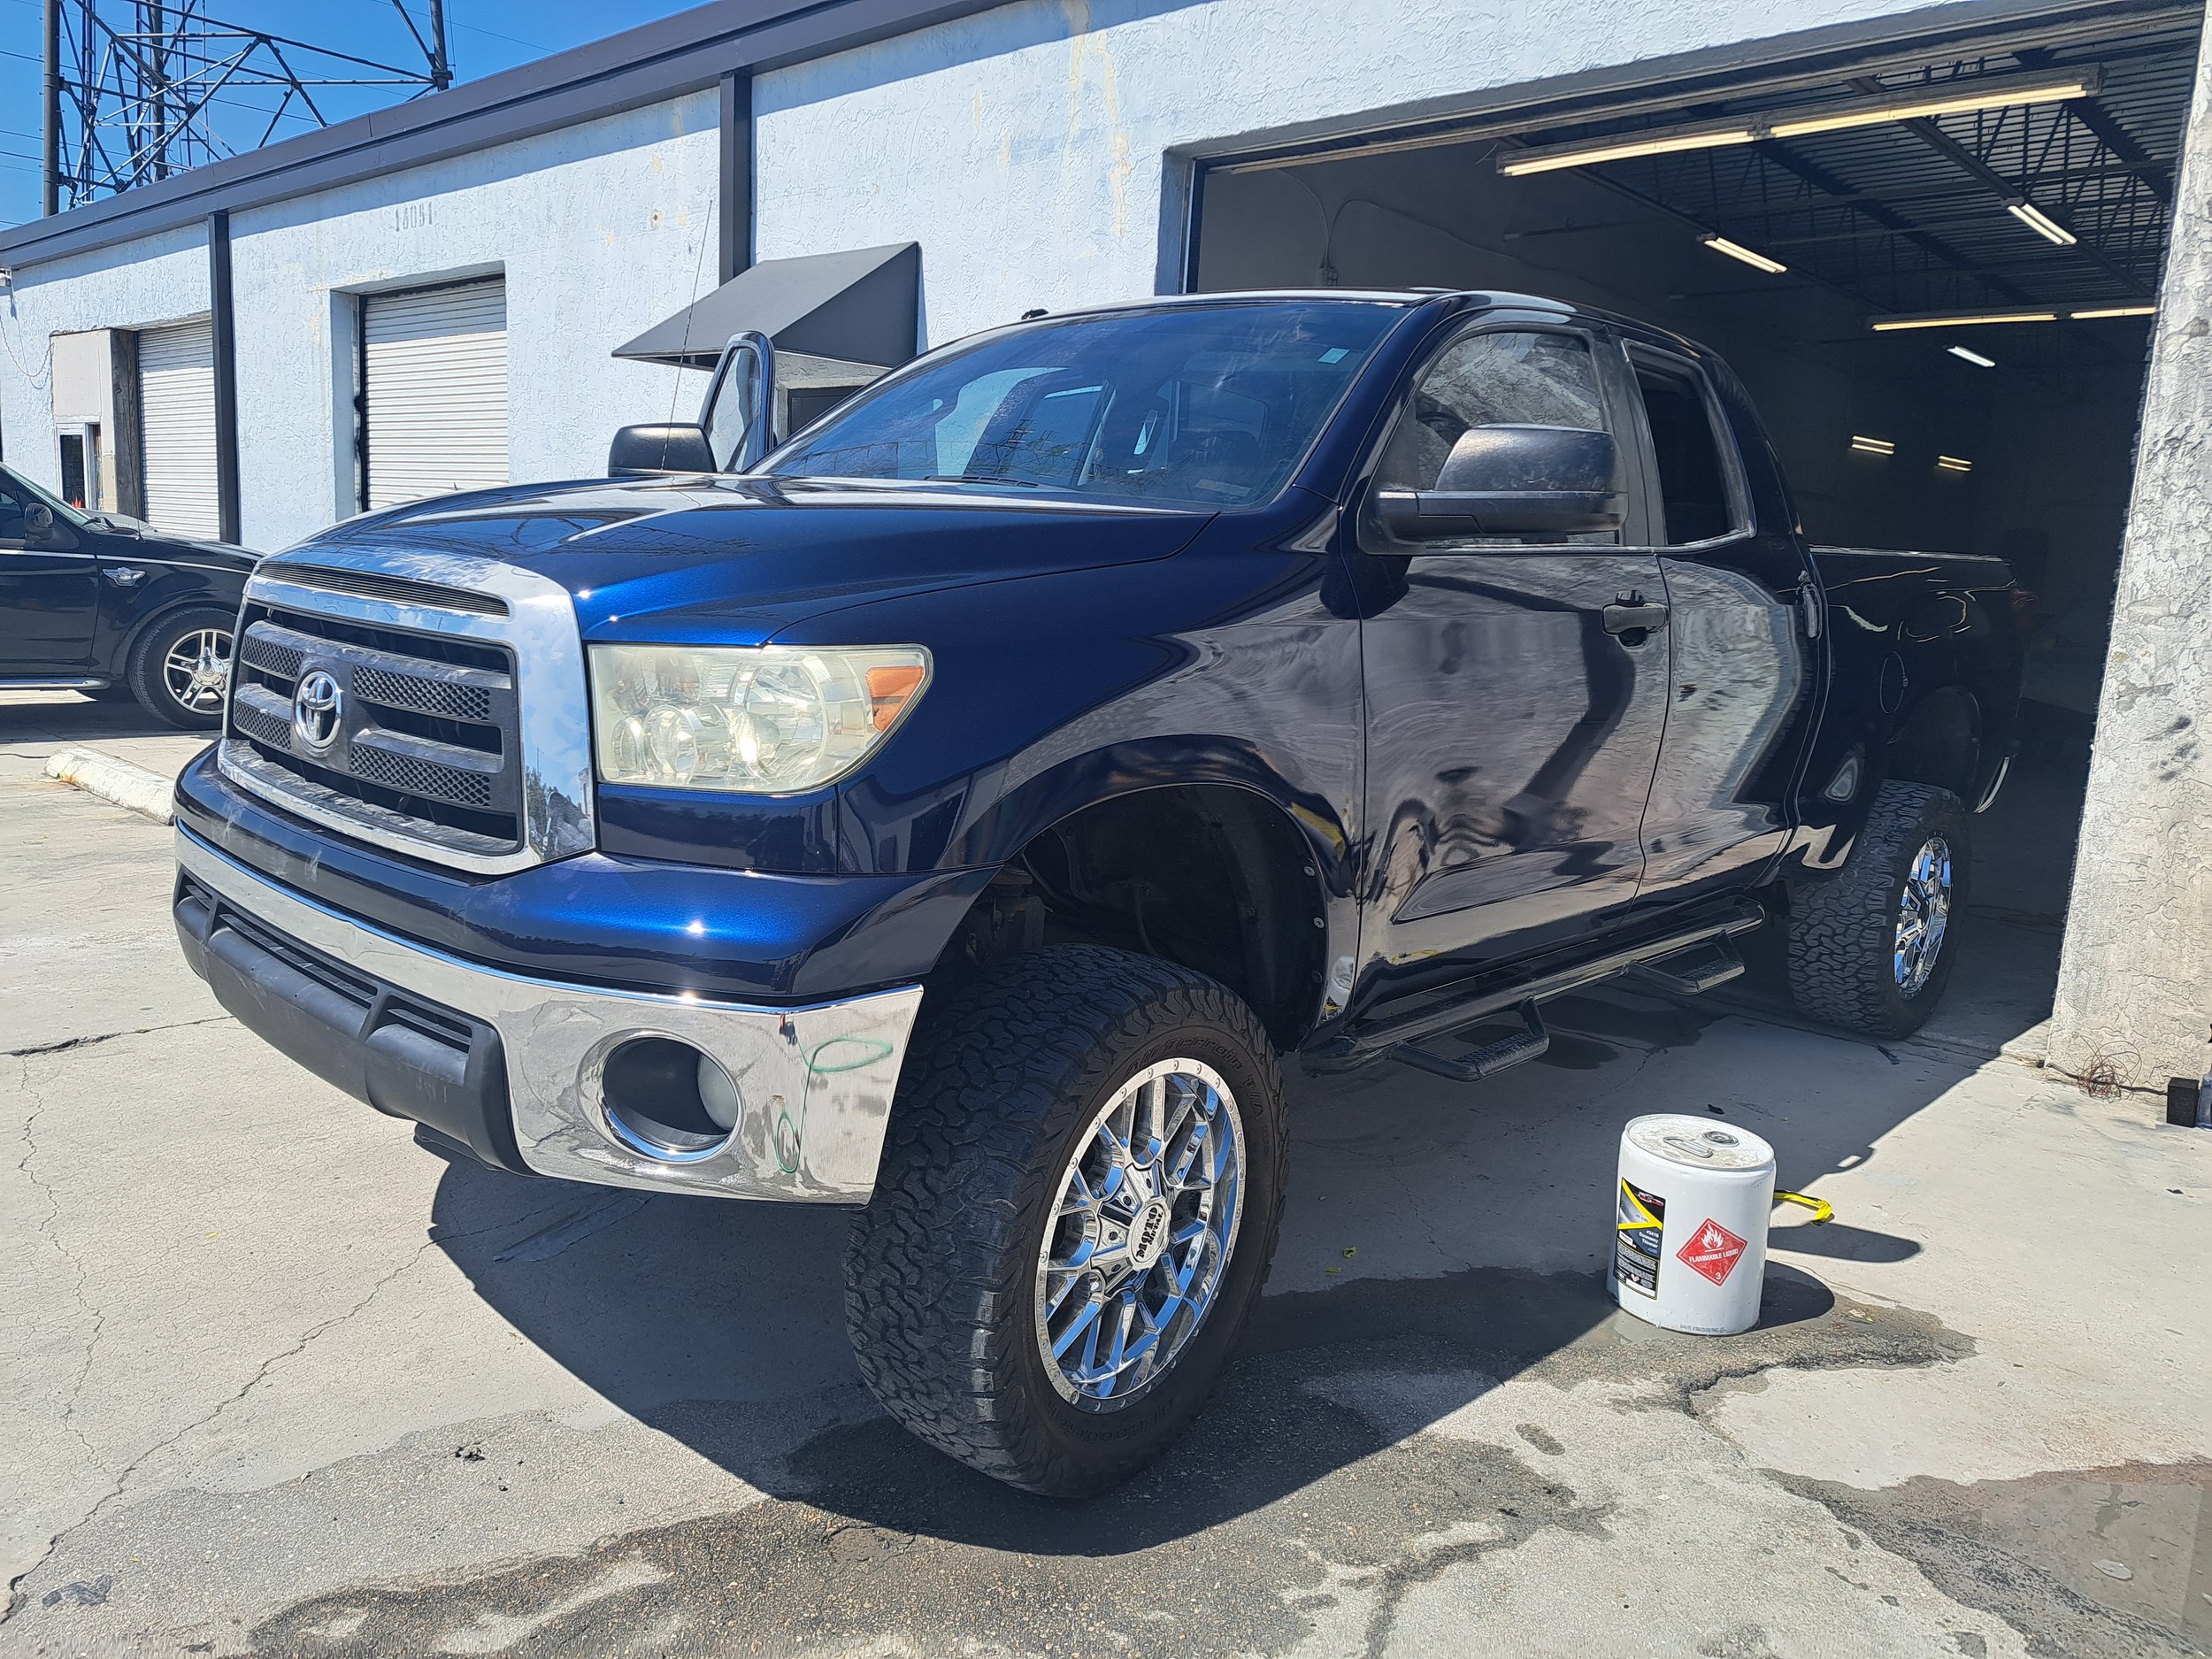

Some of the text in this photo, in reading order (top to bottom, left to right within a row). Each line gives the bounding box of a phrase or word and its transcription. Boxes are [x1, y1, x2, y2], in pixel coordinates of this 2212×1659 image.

[1136, 1207, 1158, 1258] MOTO
[1148, 1212, 1164, 1246] METAL
[1689, 1248, 1739, 1263] FLAMMABLE LIQUID
